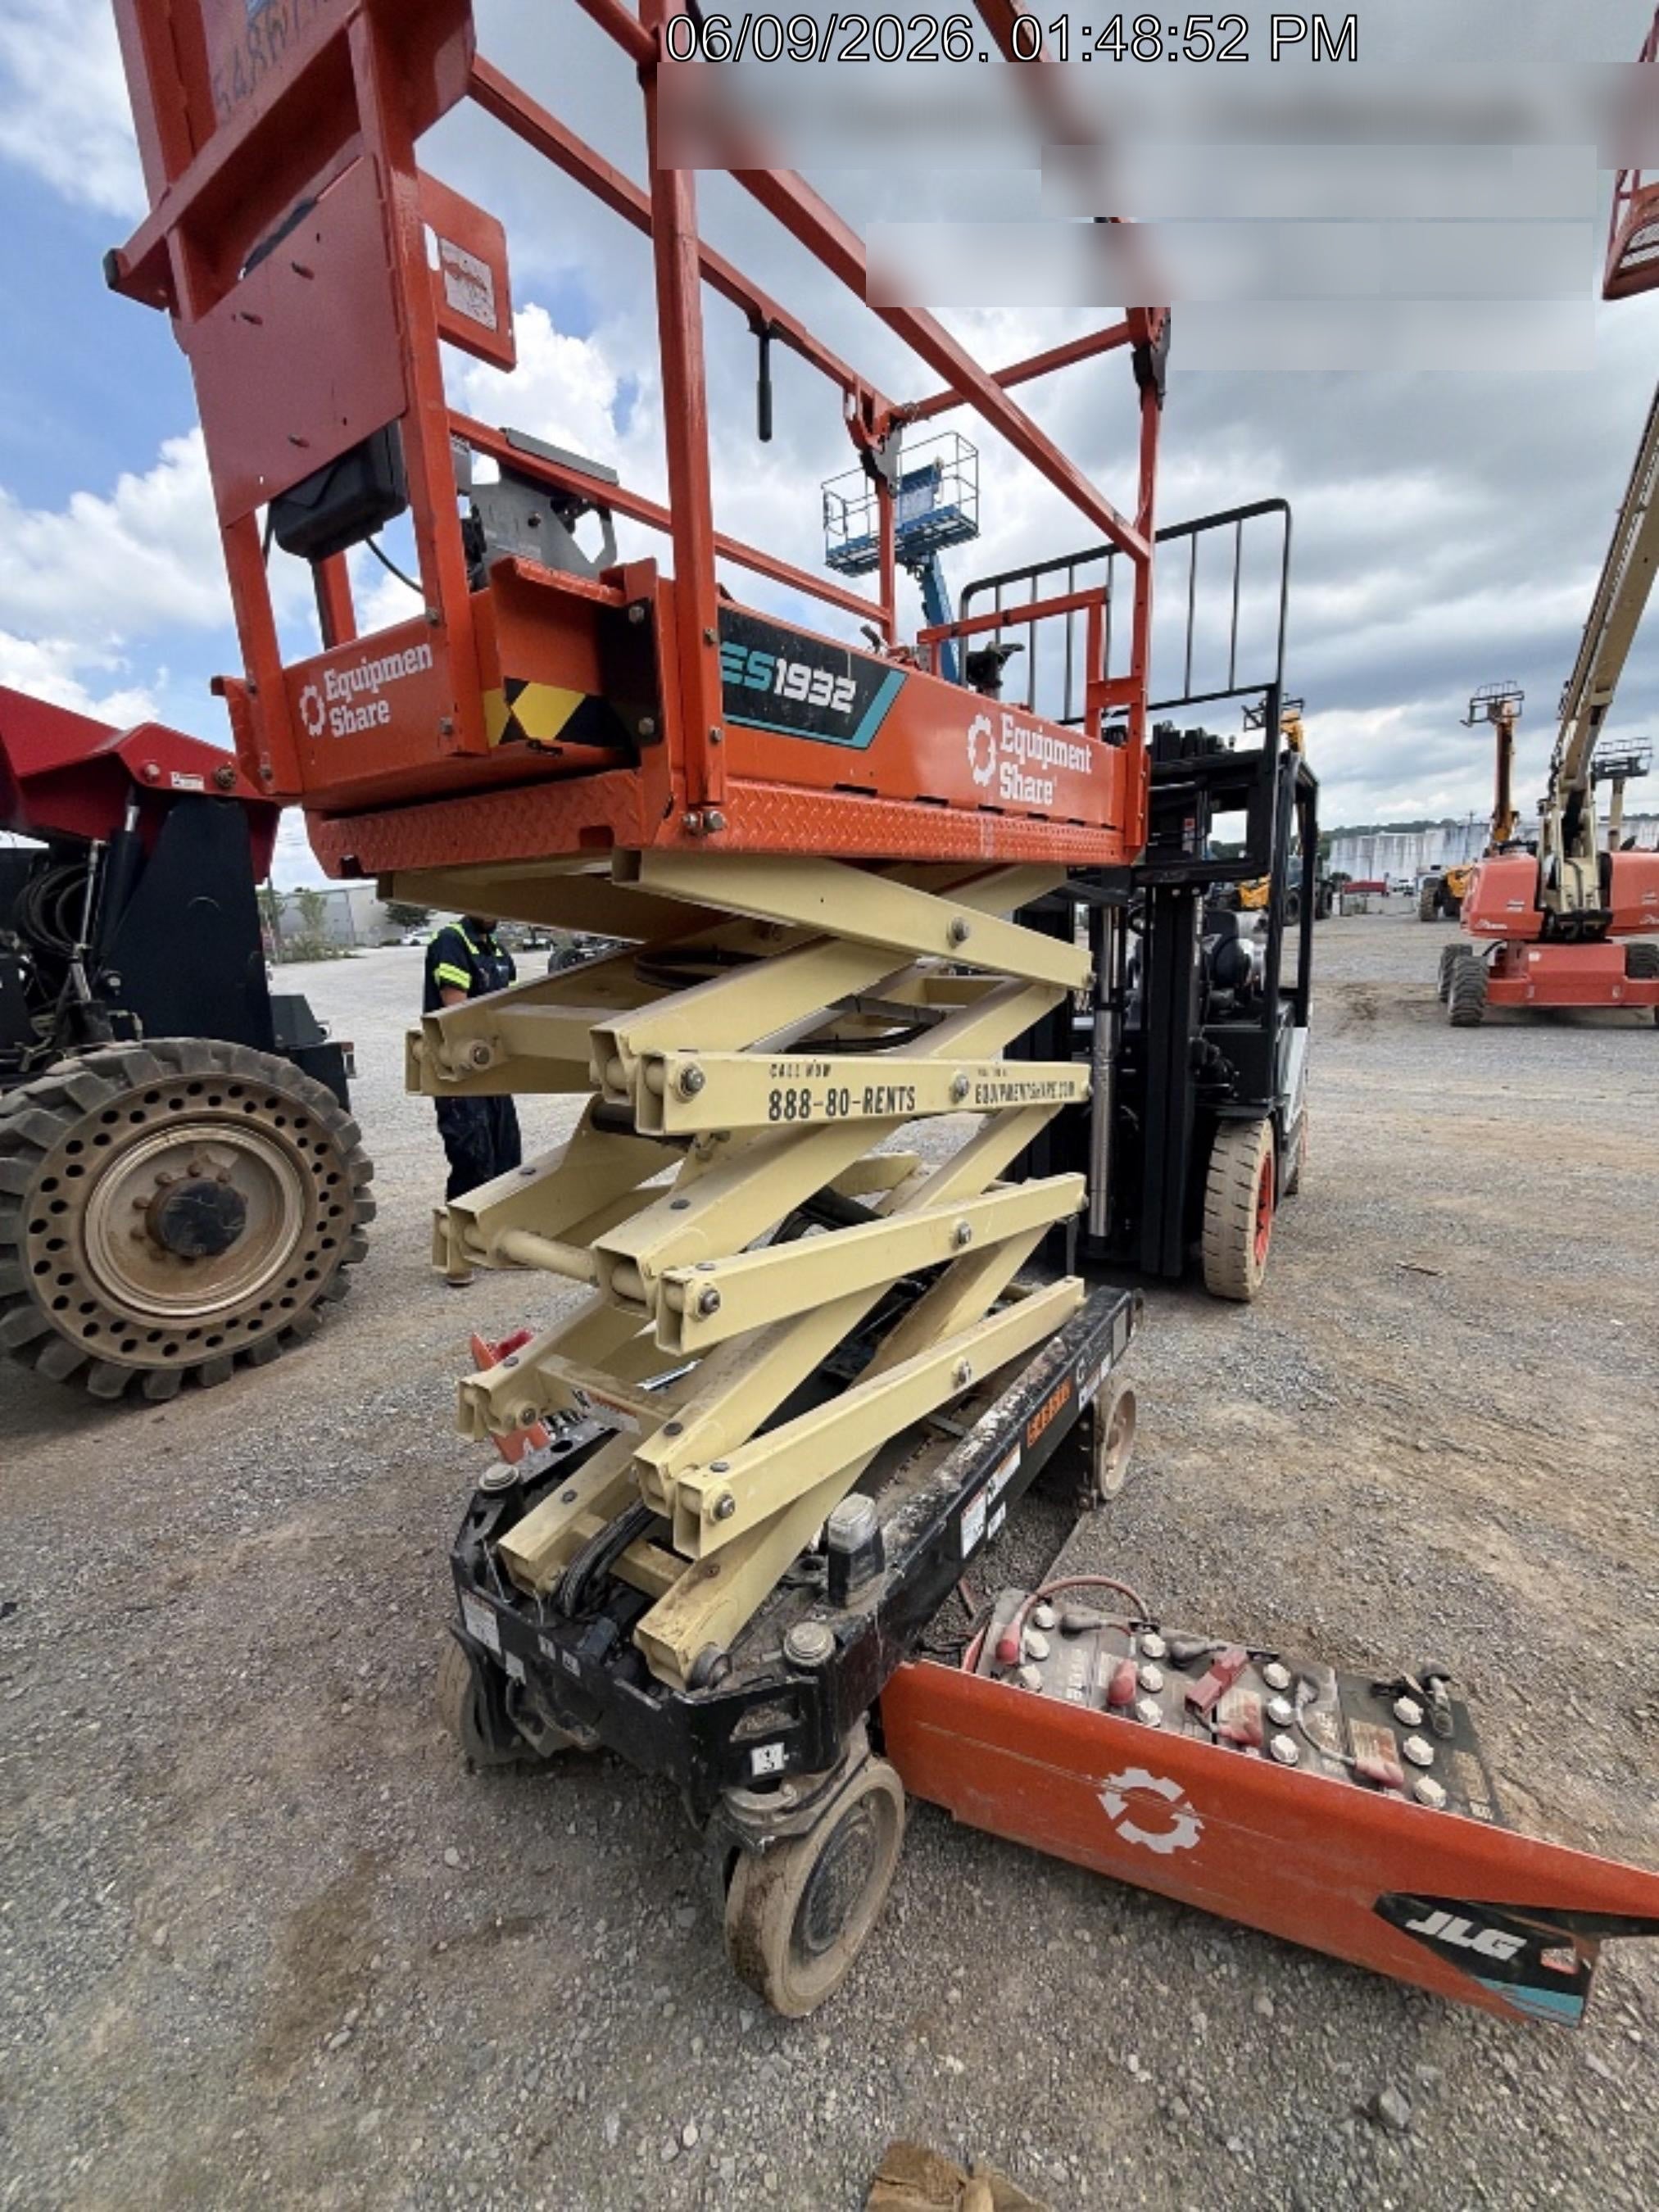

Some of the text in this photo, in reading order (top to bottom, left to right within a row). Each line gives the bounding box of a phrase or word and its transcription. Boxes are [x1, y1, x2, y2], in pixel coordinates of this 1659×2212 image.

[721, 641, 856, 714] ES1932
[330, 700, 390, 737] Share
[1000, 712, 1092, 774] Equipment
[999, 760, 1054, 805] Share
[768, 1063, 832, 1078] CALL NOW
[768, 1086, 916, 1122] 888-80-RENTS
[1406, 1911, 1527, 1960] JLG
